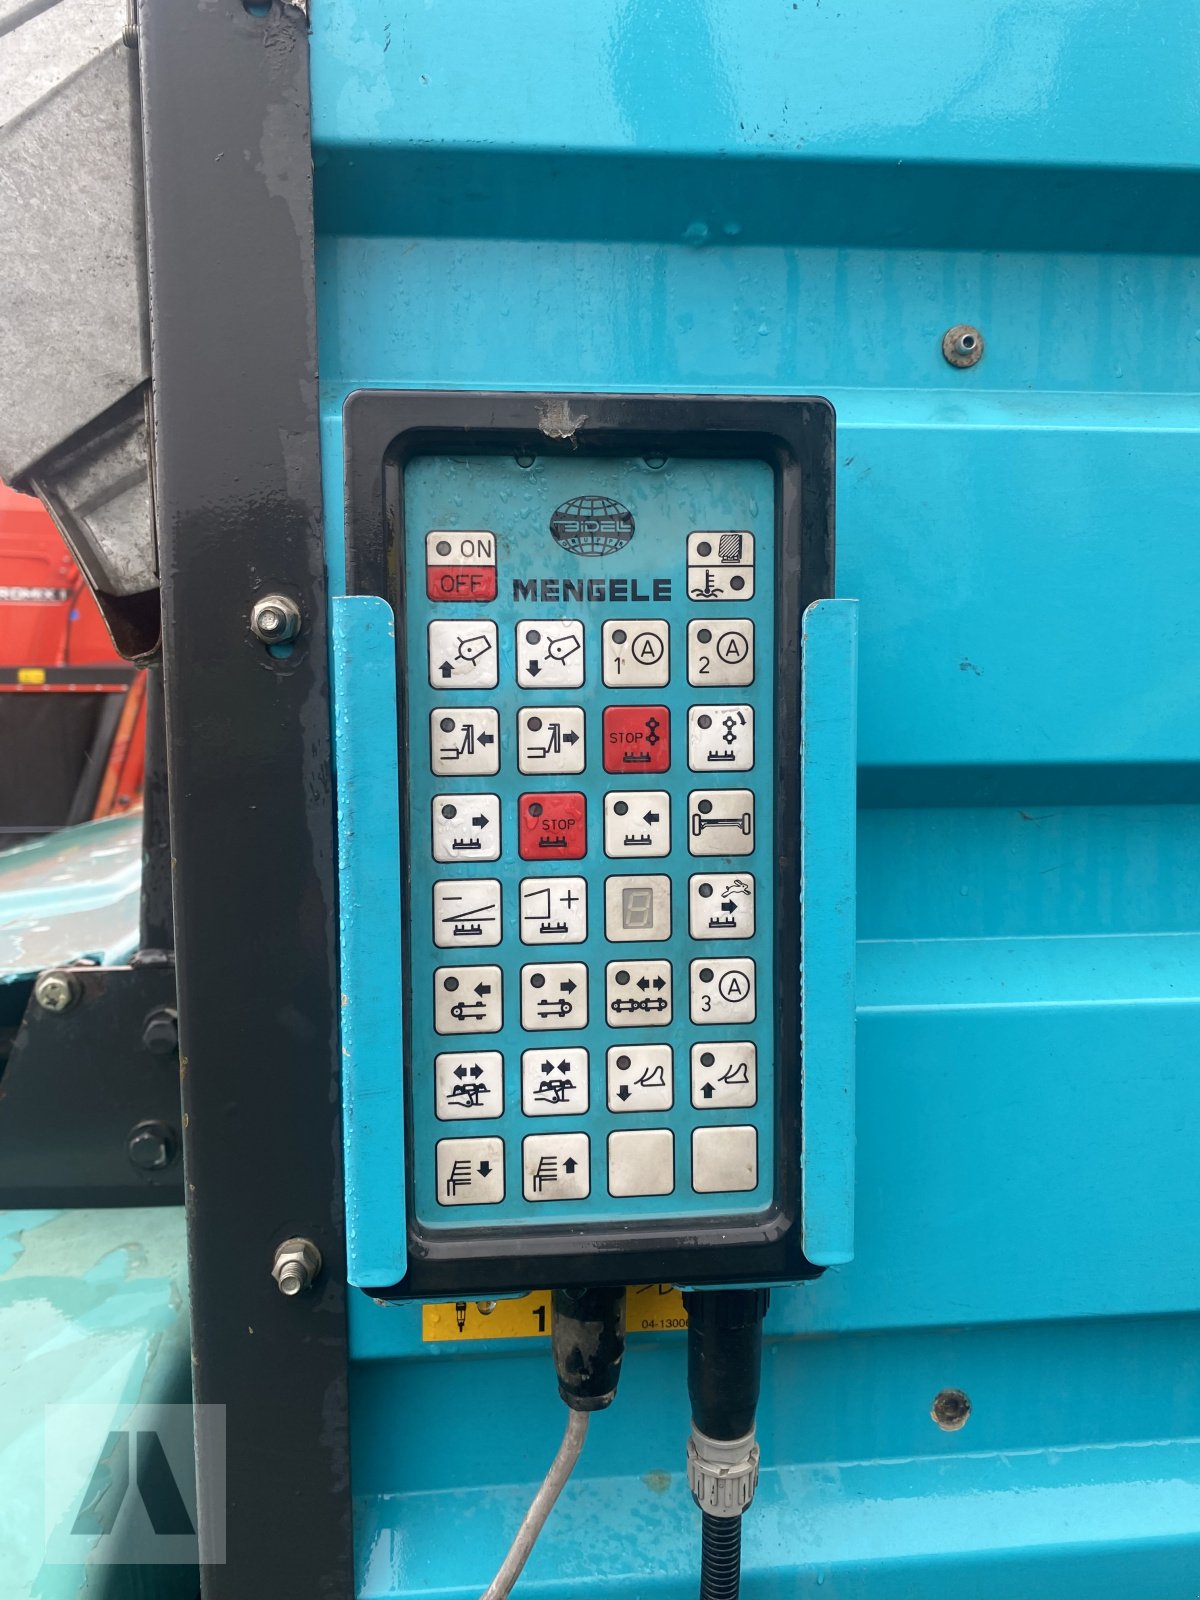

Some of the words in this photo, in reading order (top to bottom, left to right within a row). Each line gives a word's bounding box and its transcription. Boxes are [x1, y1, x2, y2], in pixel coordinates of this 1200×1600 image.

[460, 539, 492, 558] ON
[440, 574, 484, 593] OFF
[512, 578, 672, 602] MENGELE
[640, 639, 656, 658] A
[725, 638, 740, 657] A
[614, 657, 621, 675] 1
[698, 656, 710, 674] 2
[609, 732, 643, 744] STOP
[542, 819, 576, 831] STOP
[727, 977, 742, 996] A
[701, 994, 712, 1012] 3
[532, 1305, 546, 1332] 1
